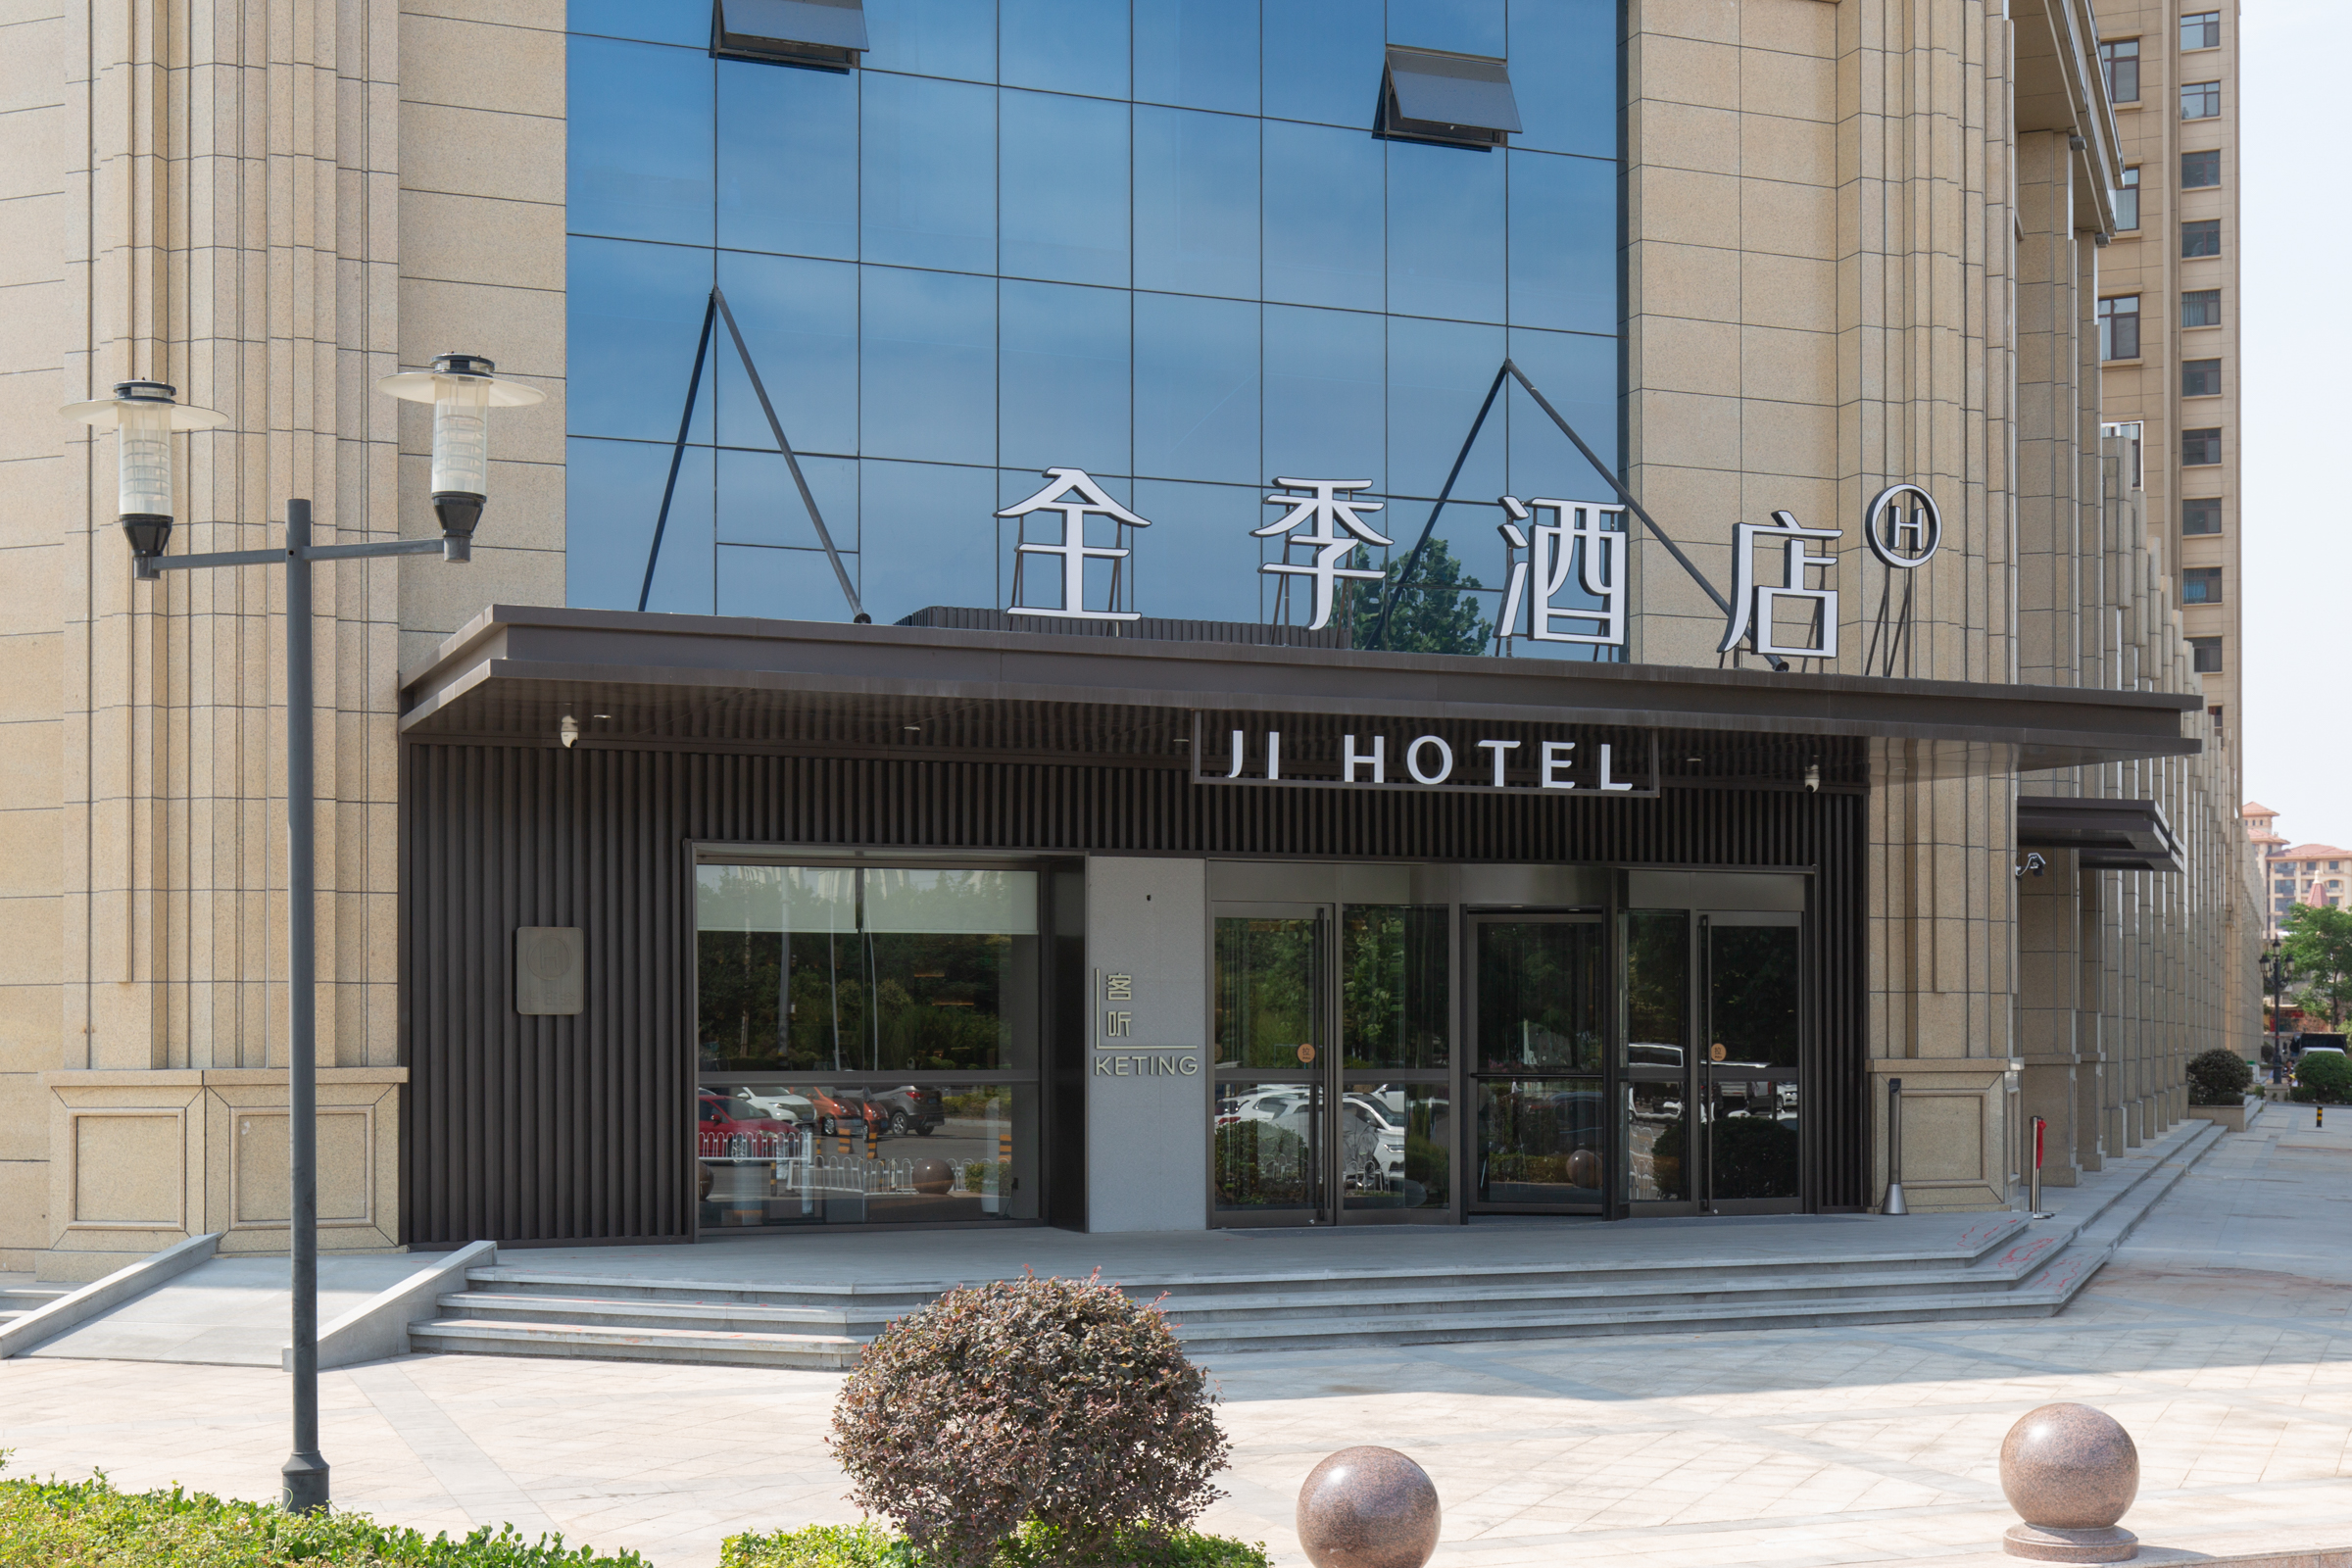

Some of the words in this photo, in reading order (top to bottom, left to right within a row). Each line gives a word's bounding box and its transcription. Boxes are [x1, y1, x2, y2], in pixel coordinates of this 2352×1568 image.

[993, 466, 1843, 660] 全季酒店
[1228, 729, 1280, 780] JI
[1344, 733, 1634, 791] HOTEL
[1095, 1055, 1199, 1076] KETING
